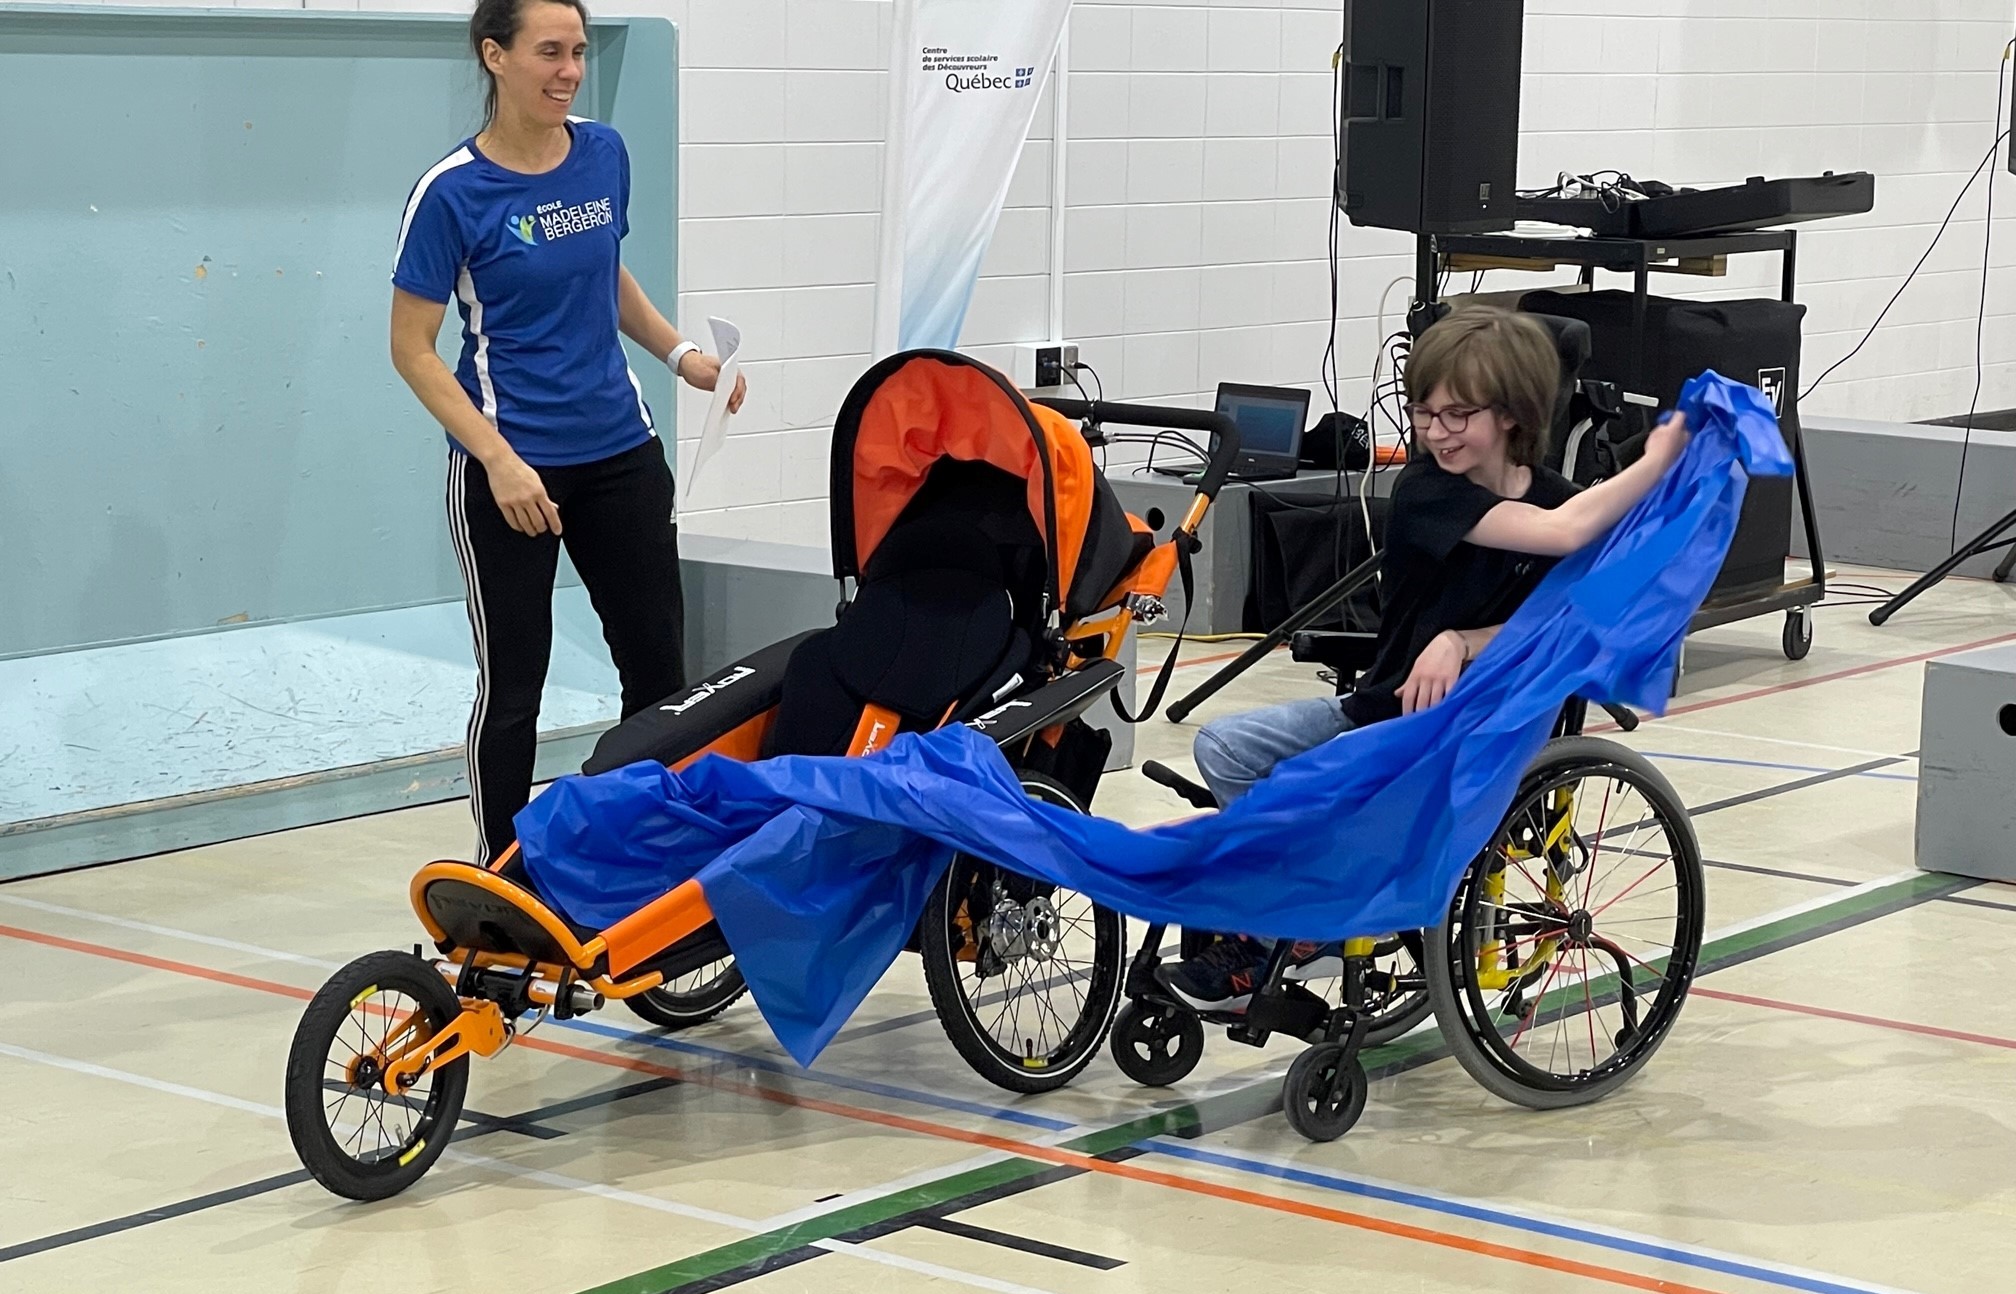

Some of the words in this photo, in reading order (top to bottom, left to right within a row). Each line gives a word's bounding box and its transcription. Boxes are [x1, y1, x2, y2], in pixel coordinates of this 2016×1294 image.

[922, 46, 948, 54] Centre
[922, 55, 932, 63] de
[933, 55, 965, 63] services
[966, 54, 999, 63] scolaire
[922, 63, 936, 71] des
[937, 63, 988, 71] Découvreurs
[945, 72, 1012, 93] Québec
[540, 197, 612, 229] MADELEINE
[545, 210, 613, 241] BERGERON
